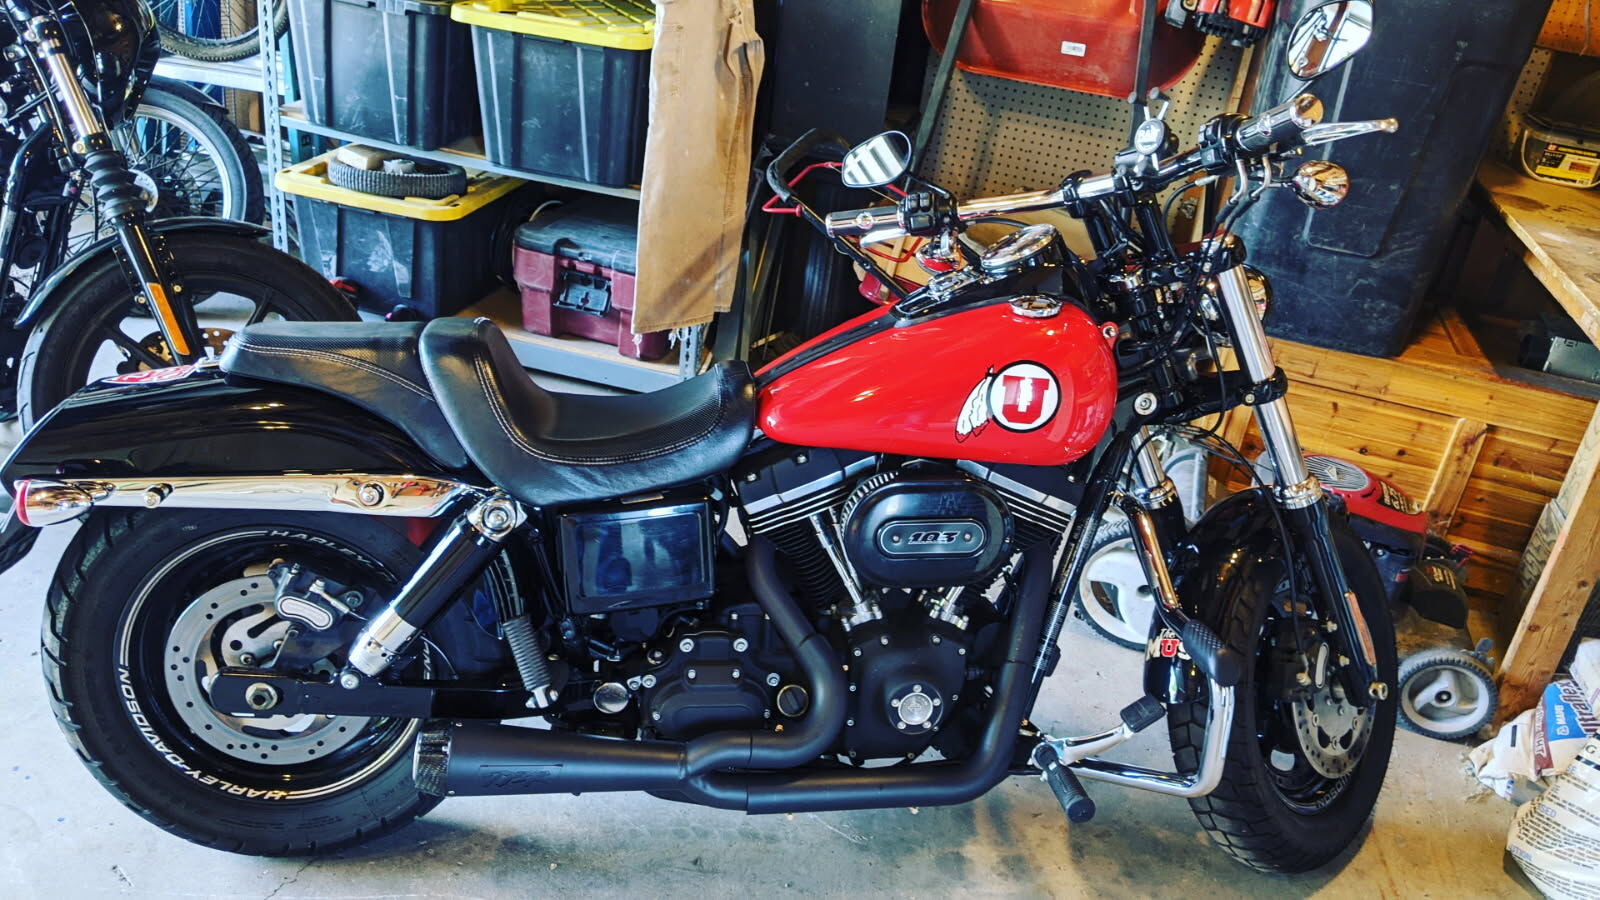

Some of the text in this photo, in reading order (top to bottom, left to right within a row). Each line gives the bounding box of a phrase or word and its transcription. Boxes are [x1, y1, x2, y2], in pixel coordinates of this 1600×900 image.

[1002, 375, 1050, 424] U
[907, 531, 961, 545] 103
[1145, 635, 1192, 661] MUS
[1559, 681, 1600, 736] ltraflex
